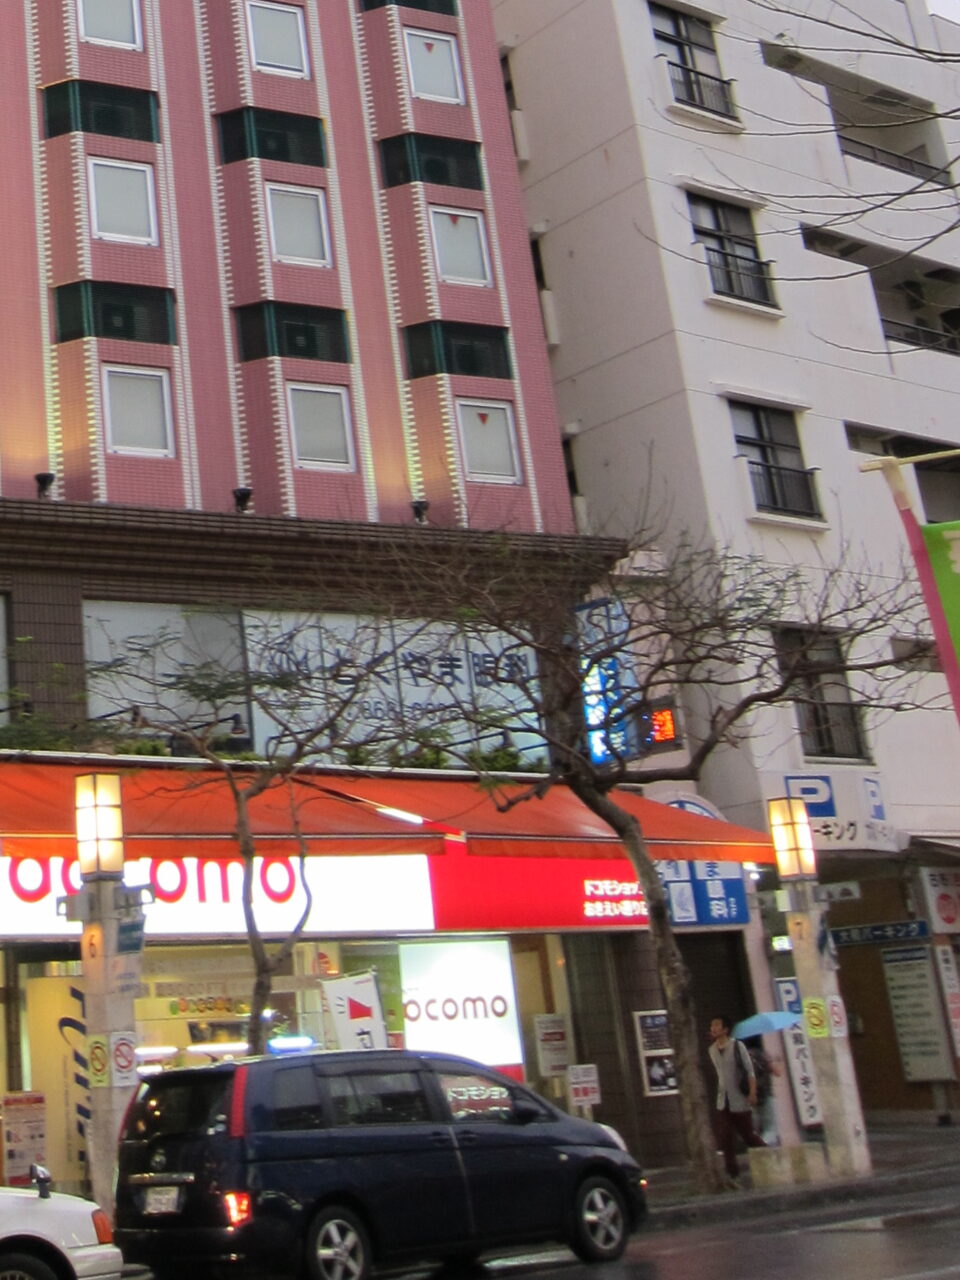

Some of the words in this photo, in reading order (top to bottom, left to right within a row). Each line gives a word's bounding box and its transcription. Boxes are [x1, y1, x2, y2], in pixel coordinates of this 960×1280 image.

[812, 821, 857, 841] ーキング
[403, 995, 508, 1022] ocomo
